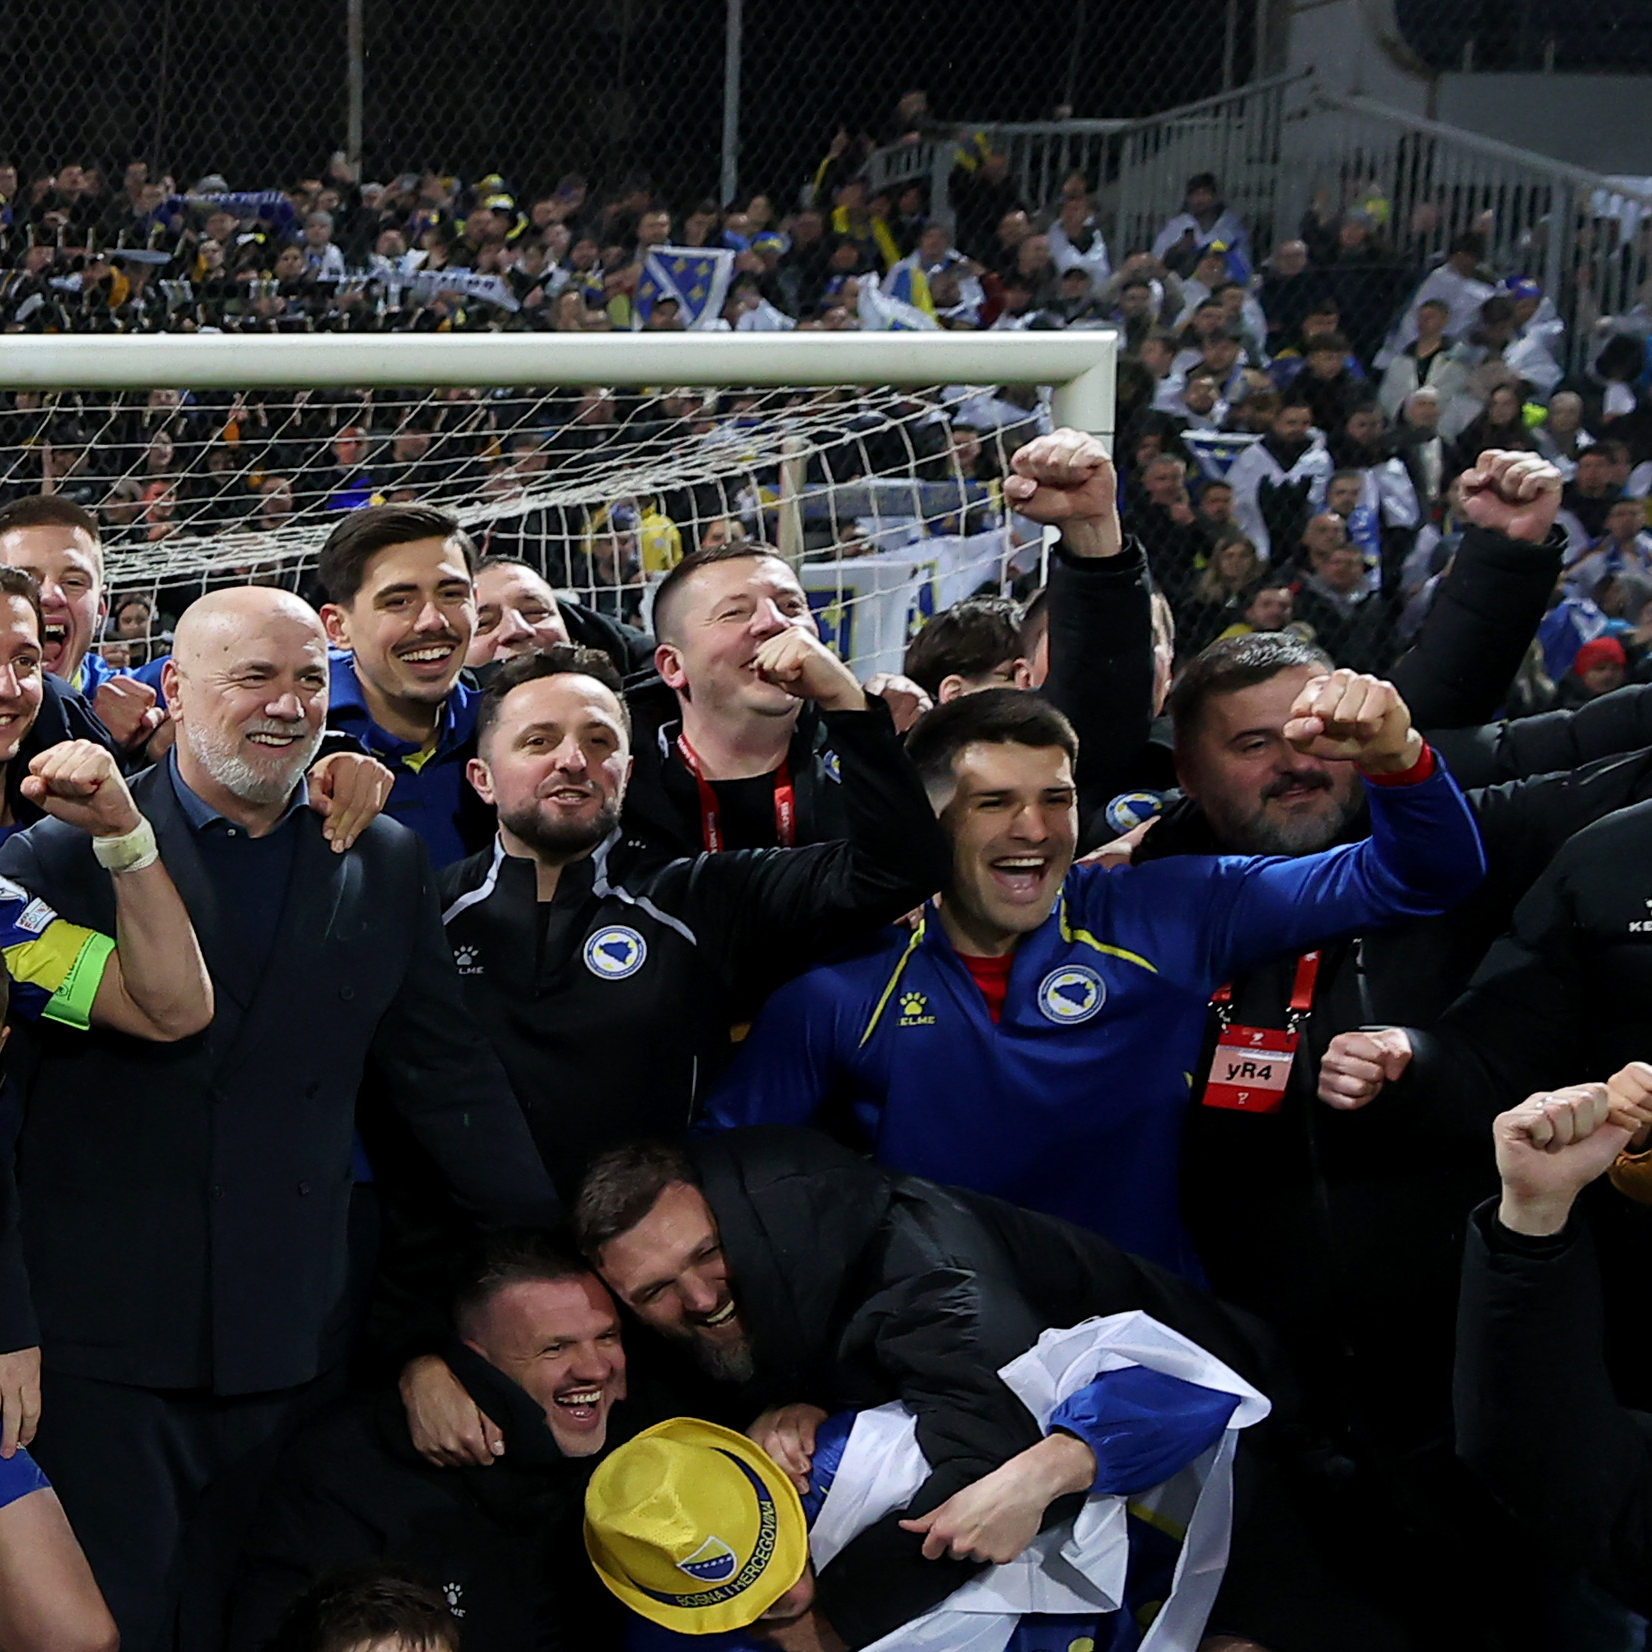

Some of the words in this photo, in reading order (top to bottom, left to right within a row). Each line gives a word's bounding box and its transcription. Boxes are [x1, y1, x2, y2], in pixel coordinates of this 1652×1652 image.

[1225, 1061, 1273, 1081] yR4
[676, 1590, 727, 1607] BOSNA
[731, 1500, 776, 1592] HERCEGOVINA
